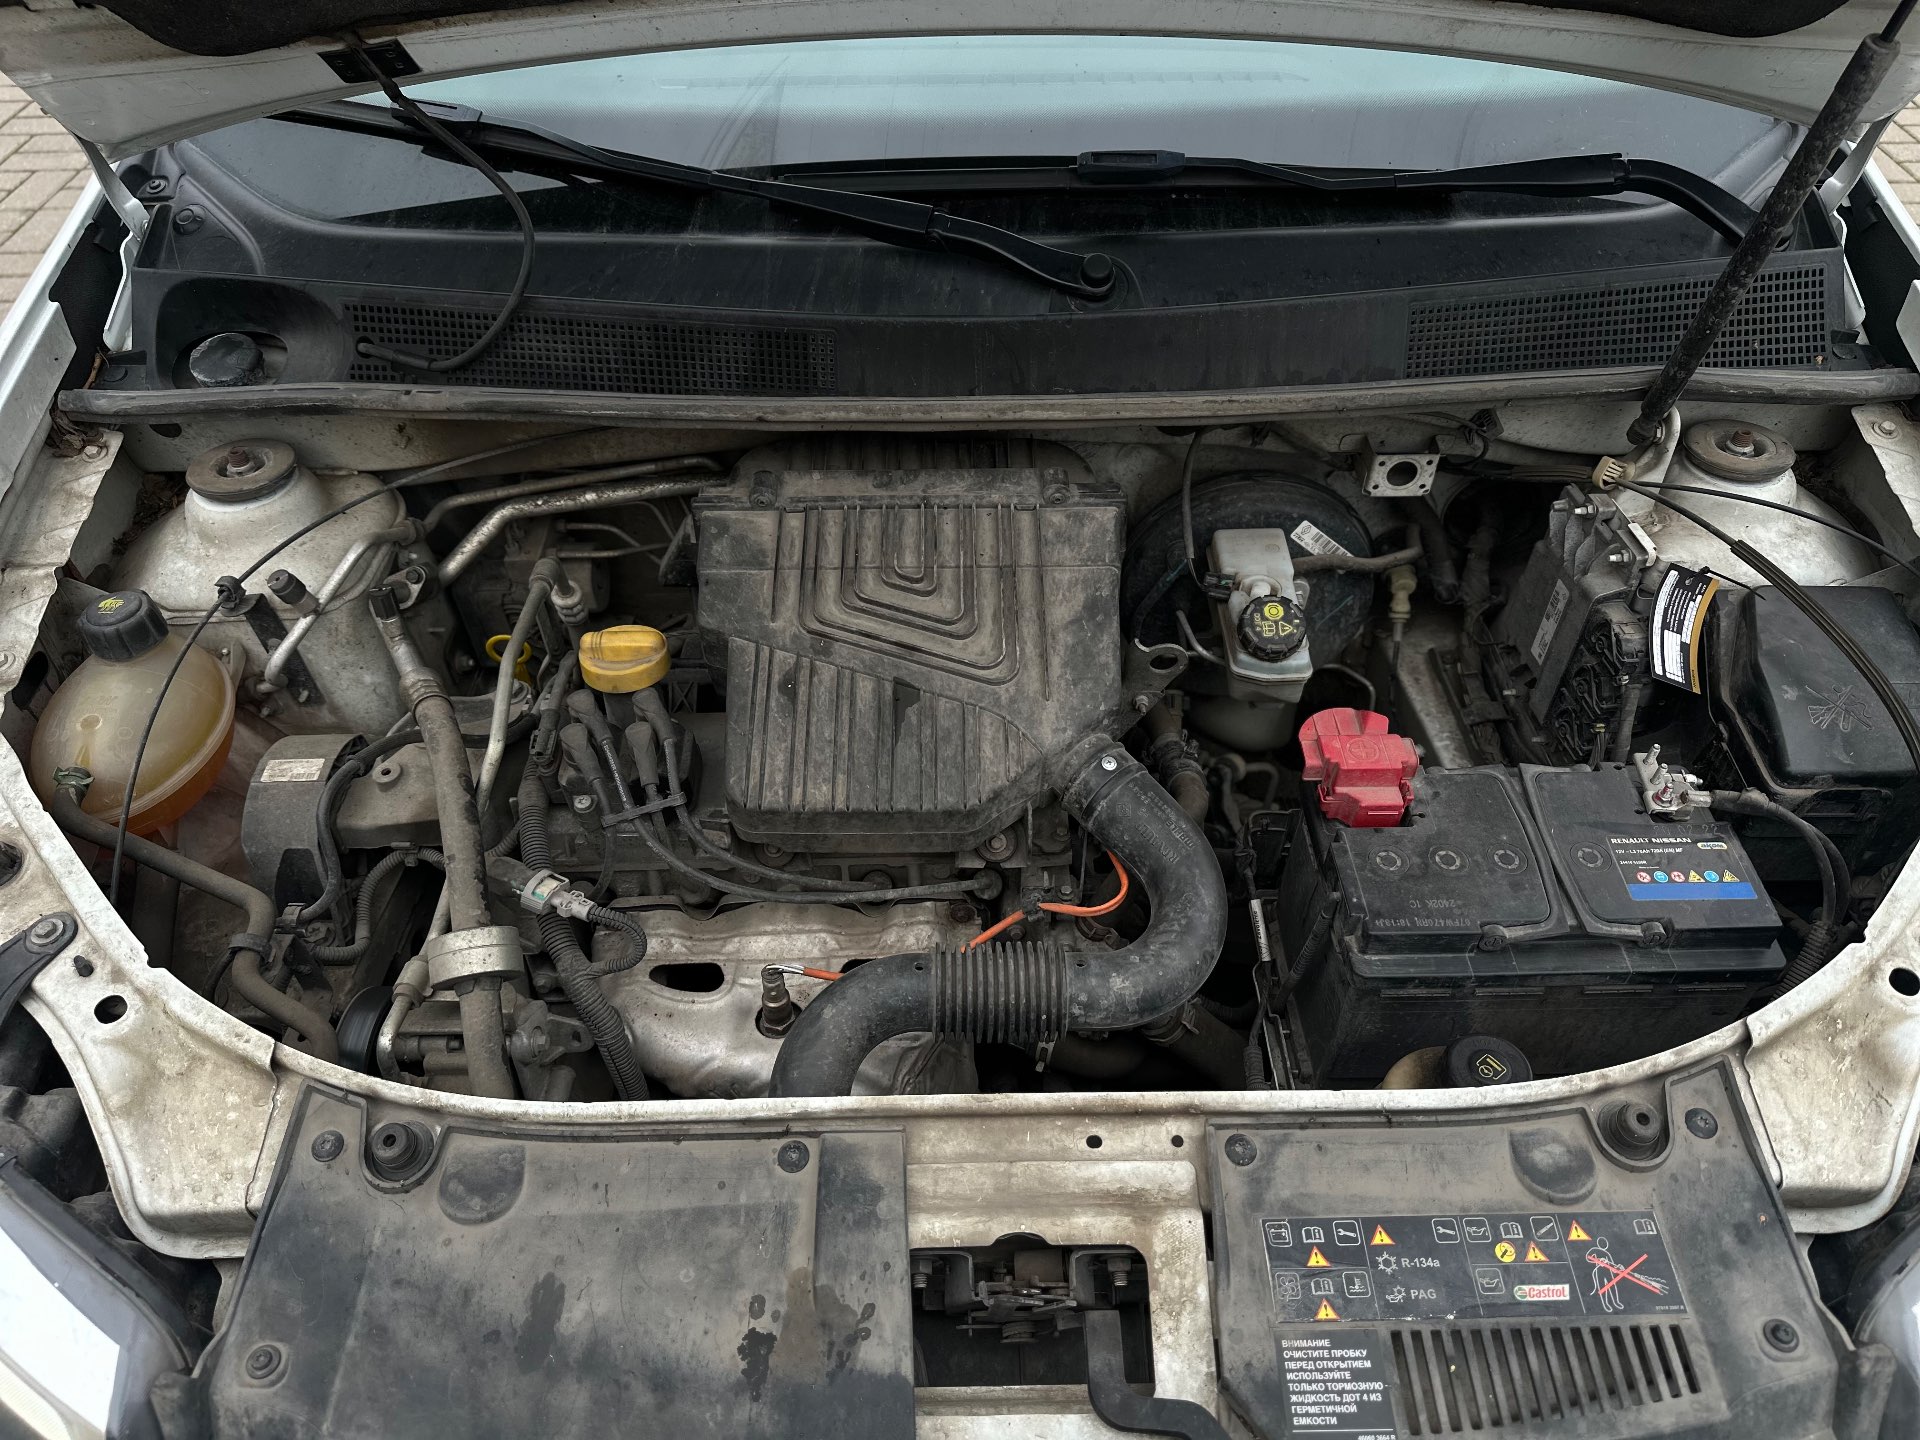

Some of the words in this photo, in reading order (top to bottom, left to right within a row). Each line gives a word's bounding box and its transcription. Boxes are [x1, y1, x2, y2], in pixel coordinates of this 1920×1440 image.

[1401, 1257, 1441, 1268] R-134a
[1410, 1289, 1437, 1300] PAG
[1527, 1286, 1567, 1299] Castrol
[1281, 1339, 1331, 1348] ВНИМАНИЕ
[1283, 1350, 1330, 1358] ОЧИСТИТЕ
[1331, 1349, 1367, 1358] ПРОБКУ
[1284, 1361, 1315, 1370] ПЕРЕД
[1316, 1360, 1371, 1369] ОТКРЫТИЕМ
[1286, 1370, 1351, 1380] ИСПОЛЬЗУЙТЕ
[1288, 1383, 1325, 1391] ТОЛЬКО
[1326, 1381, 1383, 1391] ТОРМОЗНУЮ
[1290, 1393, 1340, 1403] ЖИДКОСТЬ
[1342, 1393, 1361, 1403] ДОТ
[1362, 1393, 1368, 1401] 4
[1369, 1392, 1382, 1401] ИЗ
[1291, 1403, 1357, 1414] ГЕРМЕТИЧНОЙ
[1293, 1416, 1337, 1425] ЕМКОСТИ
